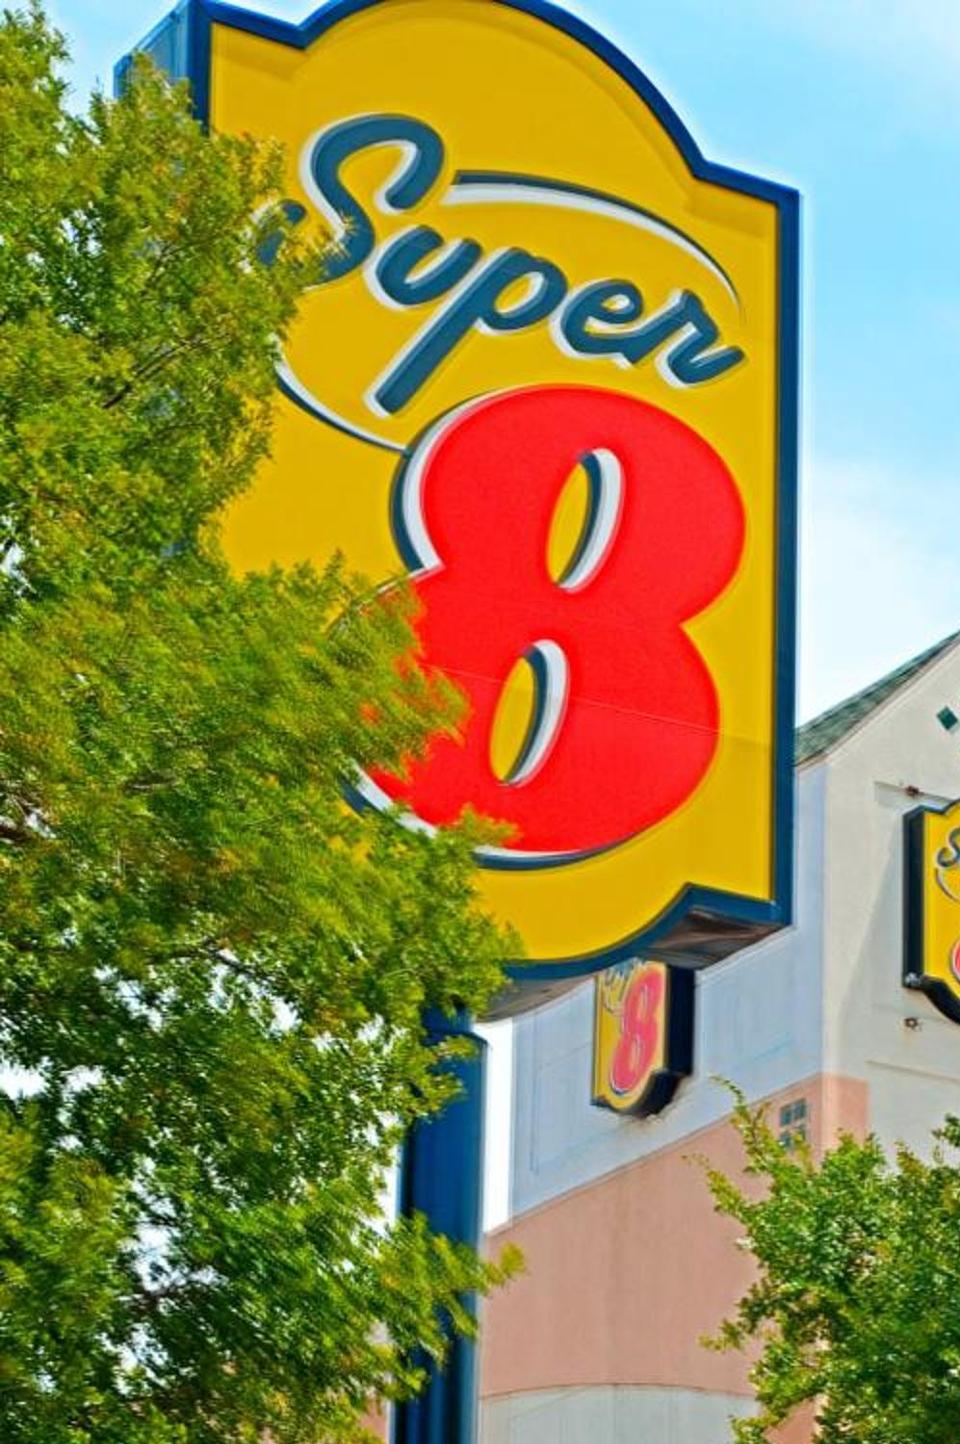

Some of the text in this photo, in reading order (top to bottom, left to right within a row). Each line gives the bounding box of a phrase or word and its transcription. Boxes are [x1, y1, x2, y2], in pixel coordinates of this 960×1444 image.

[250, 111, 746, 417] Super
[337, 382, 747, 872] 8
[610, 968, 664, 1095] 8
